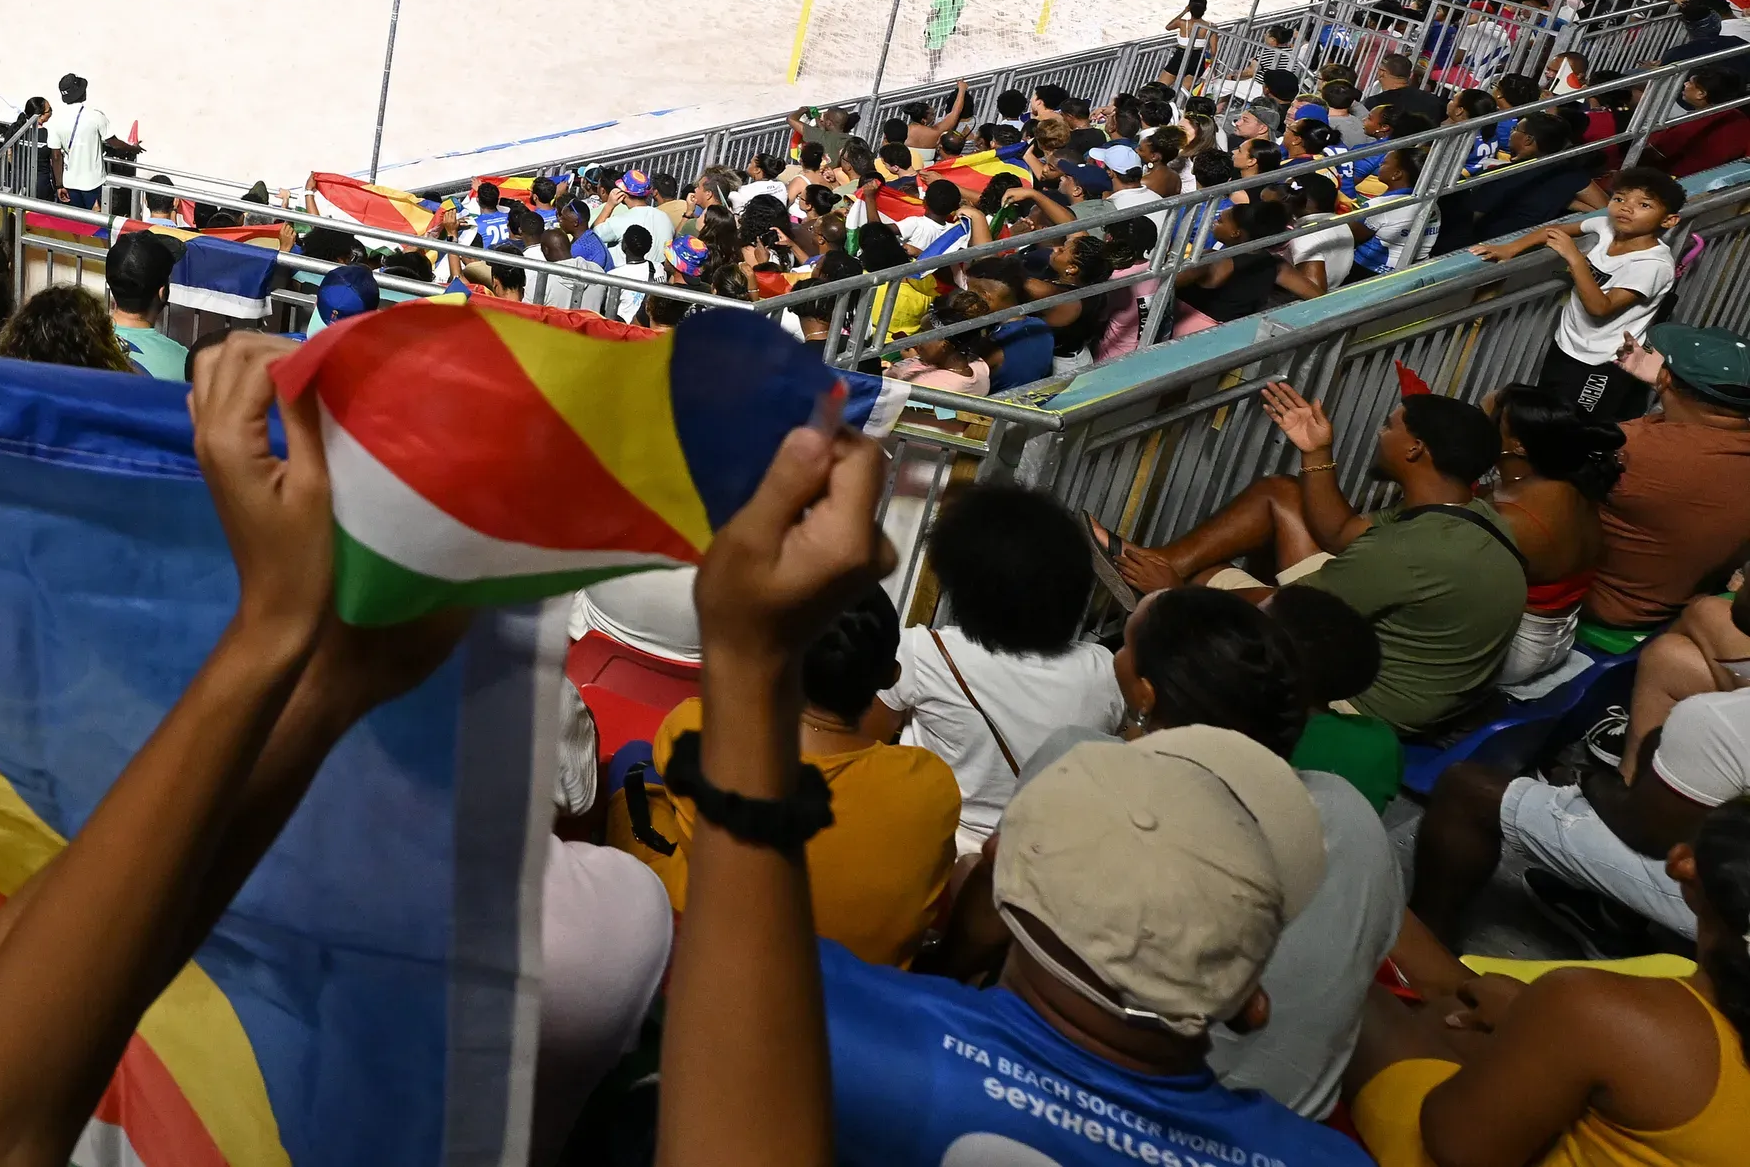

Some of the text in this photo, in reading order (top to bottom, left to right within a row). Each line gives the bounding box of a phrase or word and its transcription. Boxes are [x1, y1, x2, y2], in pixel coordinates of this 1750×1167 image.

[942, 1034, 992, 1068] FIFA
[997, 1056, 1072, 1102] BEACH
[1075, 1089, 1164, 1138] SOCCER
[1167, 1124, 1248, 1167] WORLD
